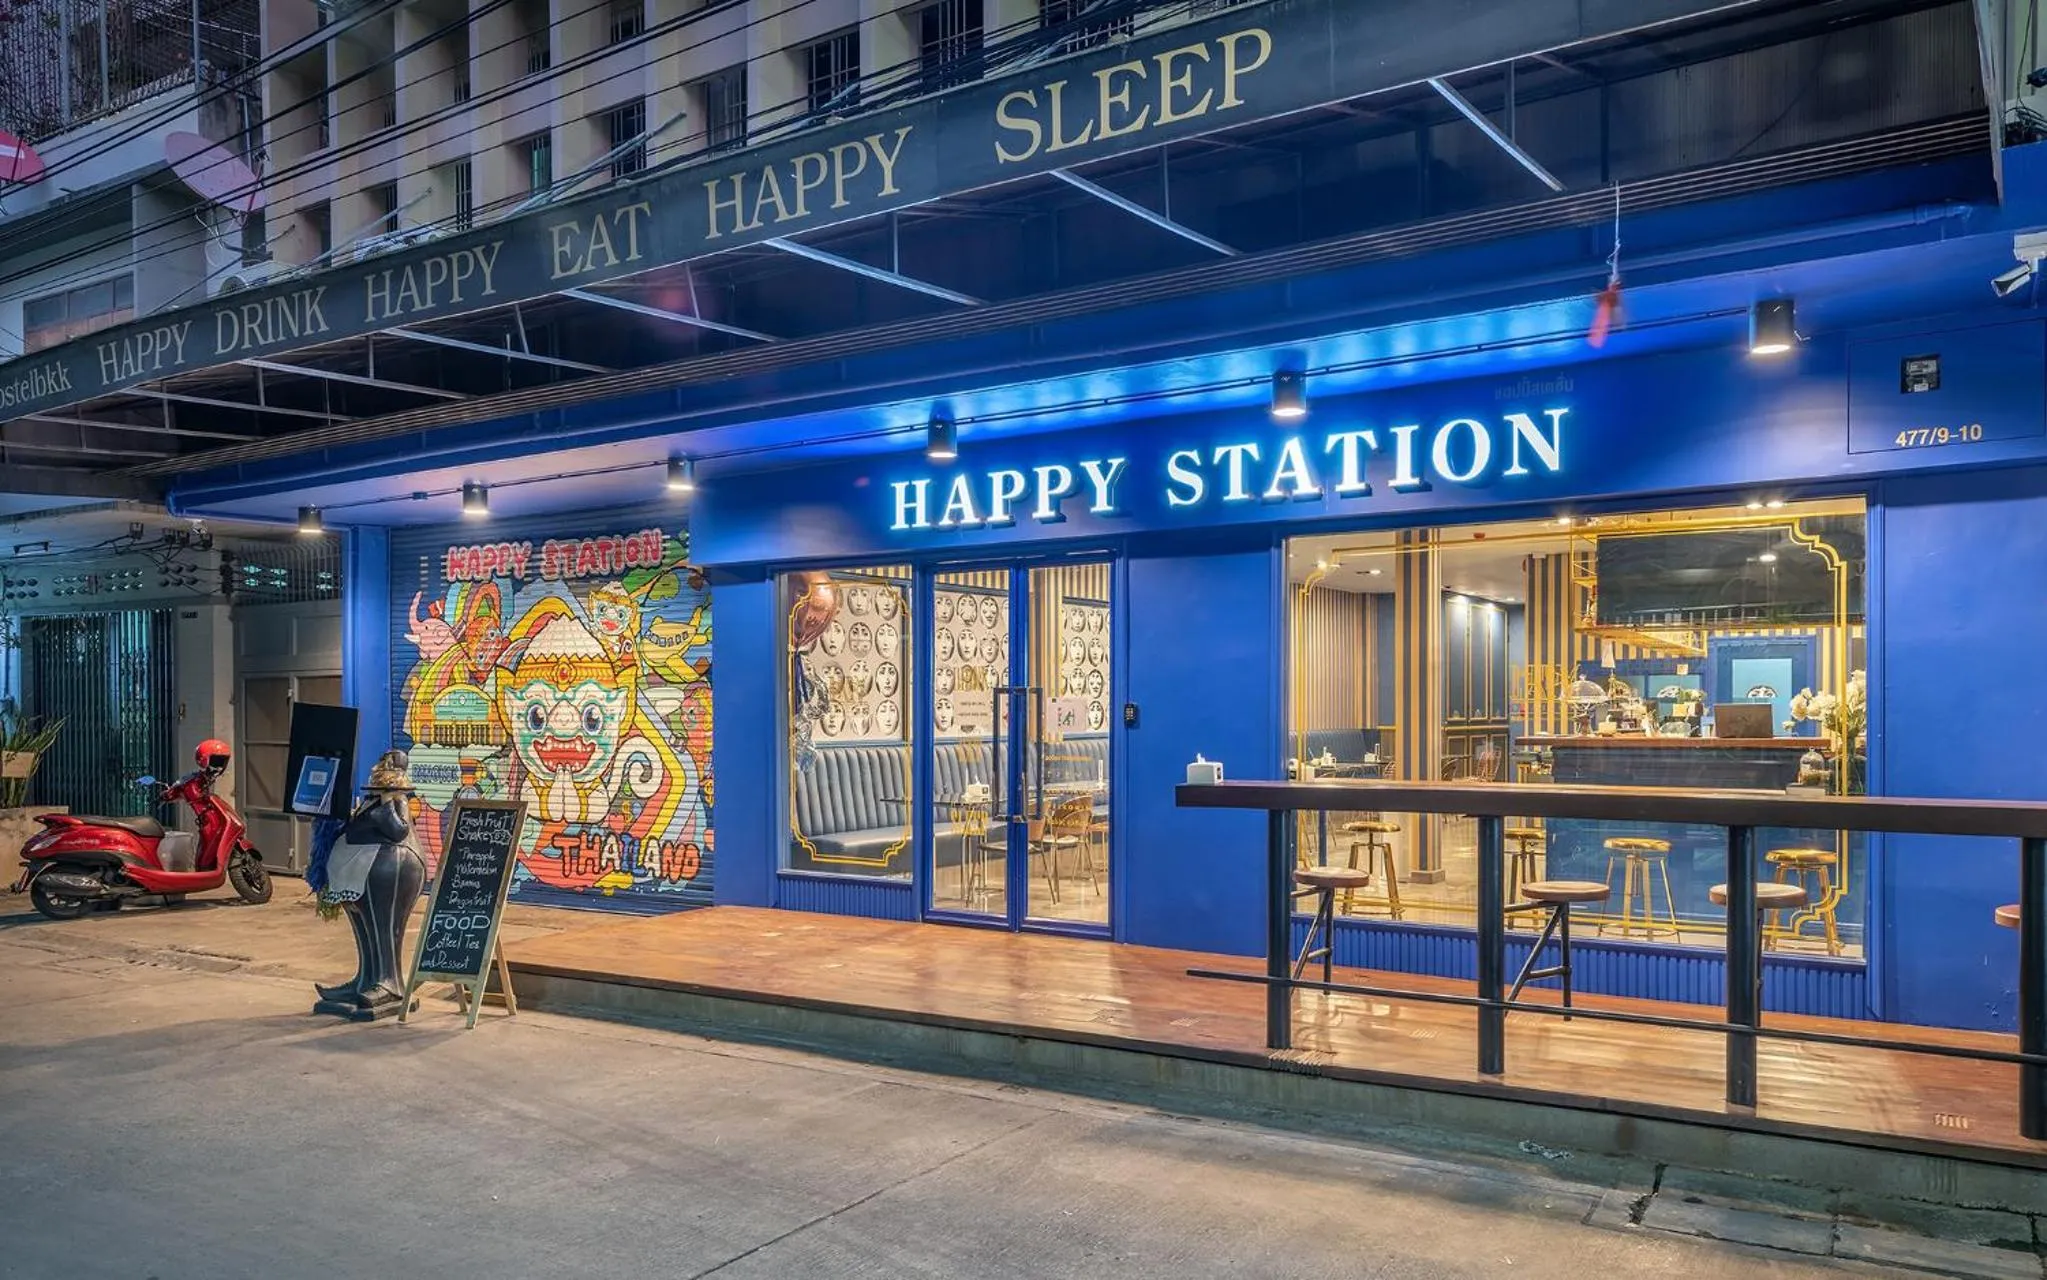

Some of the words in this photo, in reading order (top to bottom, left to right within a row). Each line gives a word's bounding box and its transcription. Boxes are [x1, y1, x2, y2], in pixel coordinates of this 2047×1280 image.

[97, 320, 193, 386] HAPPY
[215, 286, 329, 355] DRINK
[364, 240, 504, 323] HAPPY
[549, 201, 651, 280] EAT
[703, 126, 913, 240] HAPPY
[995, 28, 1272, 165] SLEEP
[1895, 424, 1982, 447] 477/9-10
[890, 457, 1127, 531] HAPPY
[1166, 408, 1570, 506] STATION
[447, 540, 532, 581] HAPPY
[541, 528, 663, 580] STATION
[551, 830, 701, 884] THAILAND
[432, 914, 491, 930] FOOD
